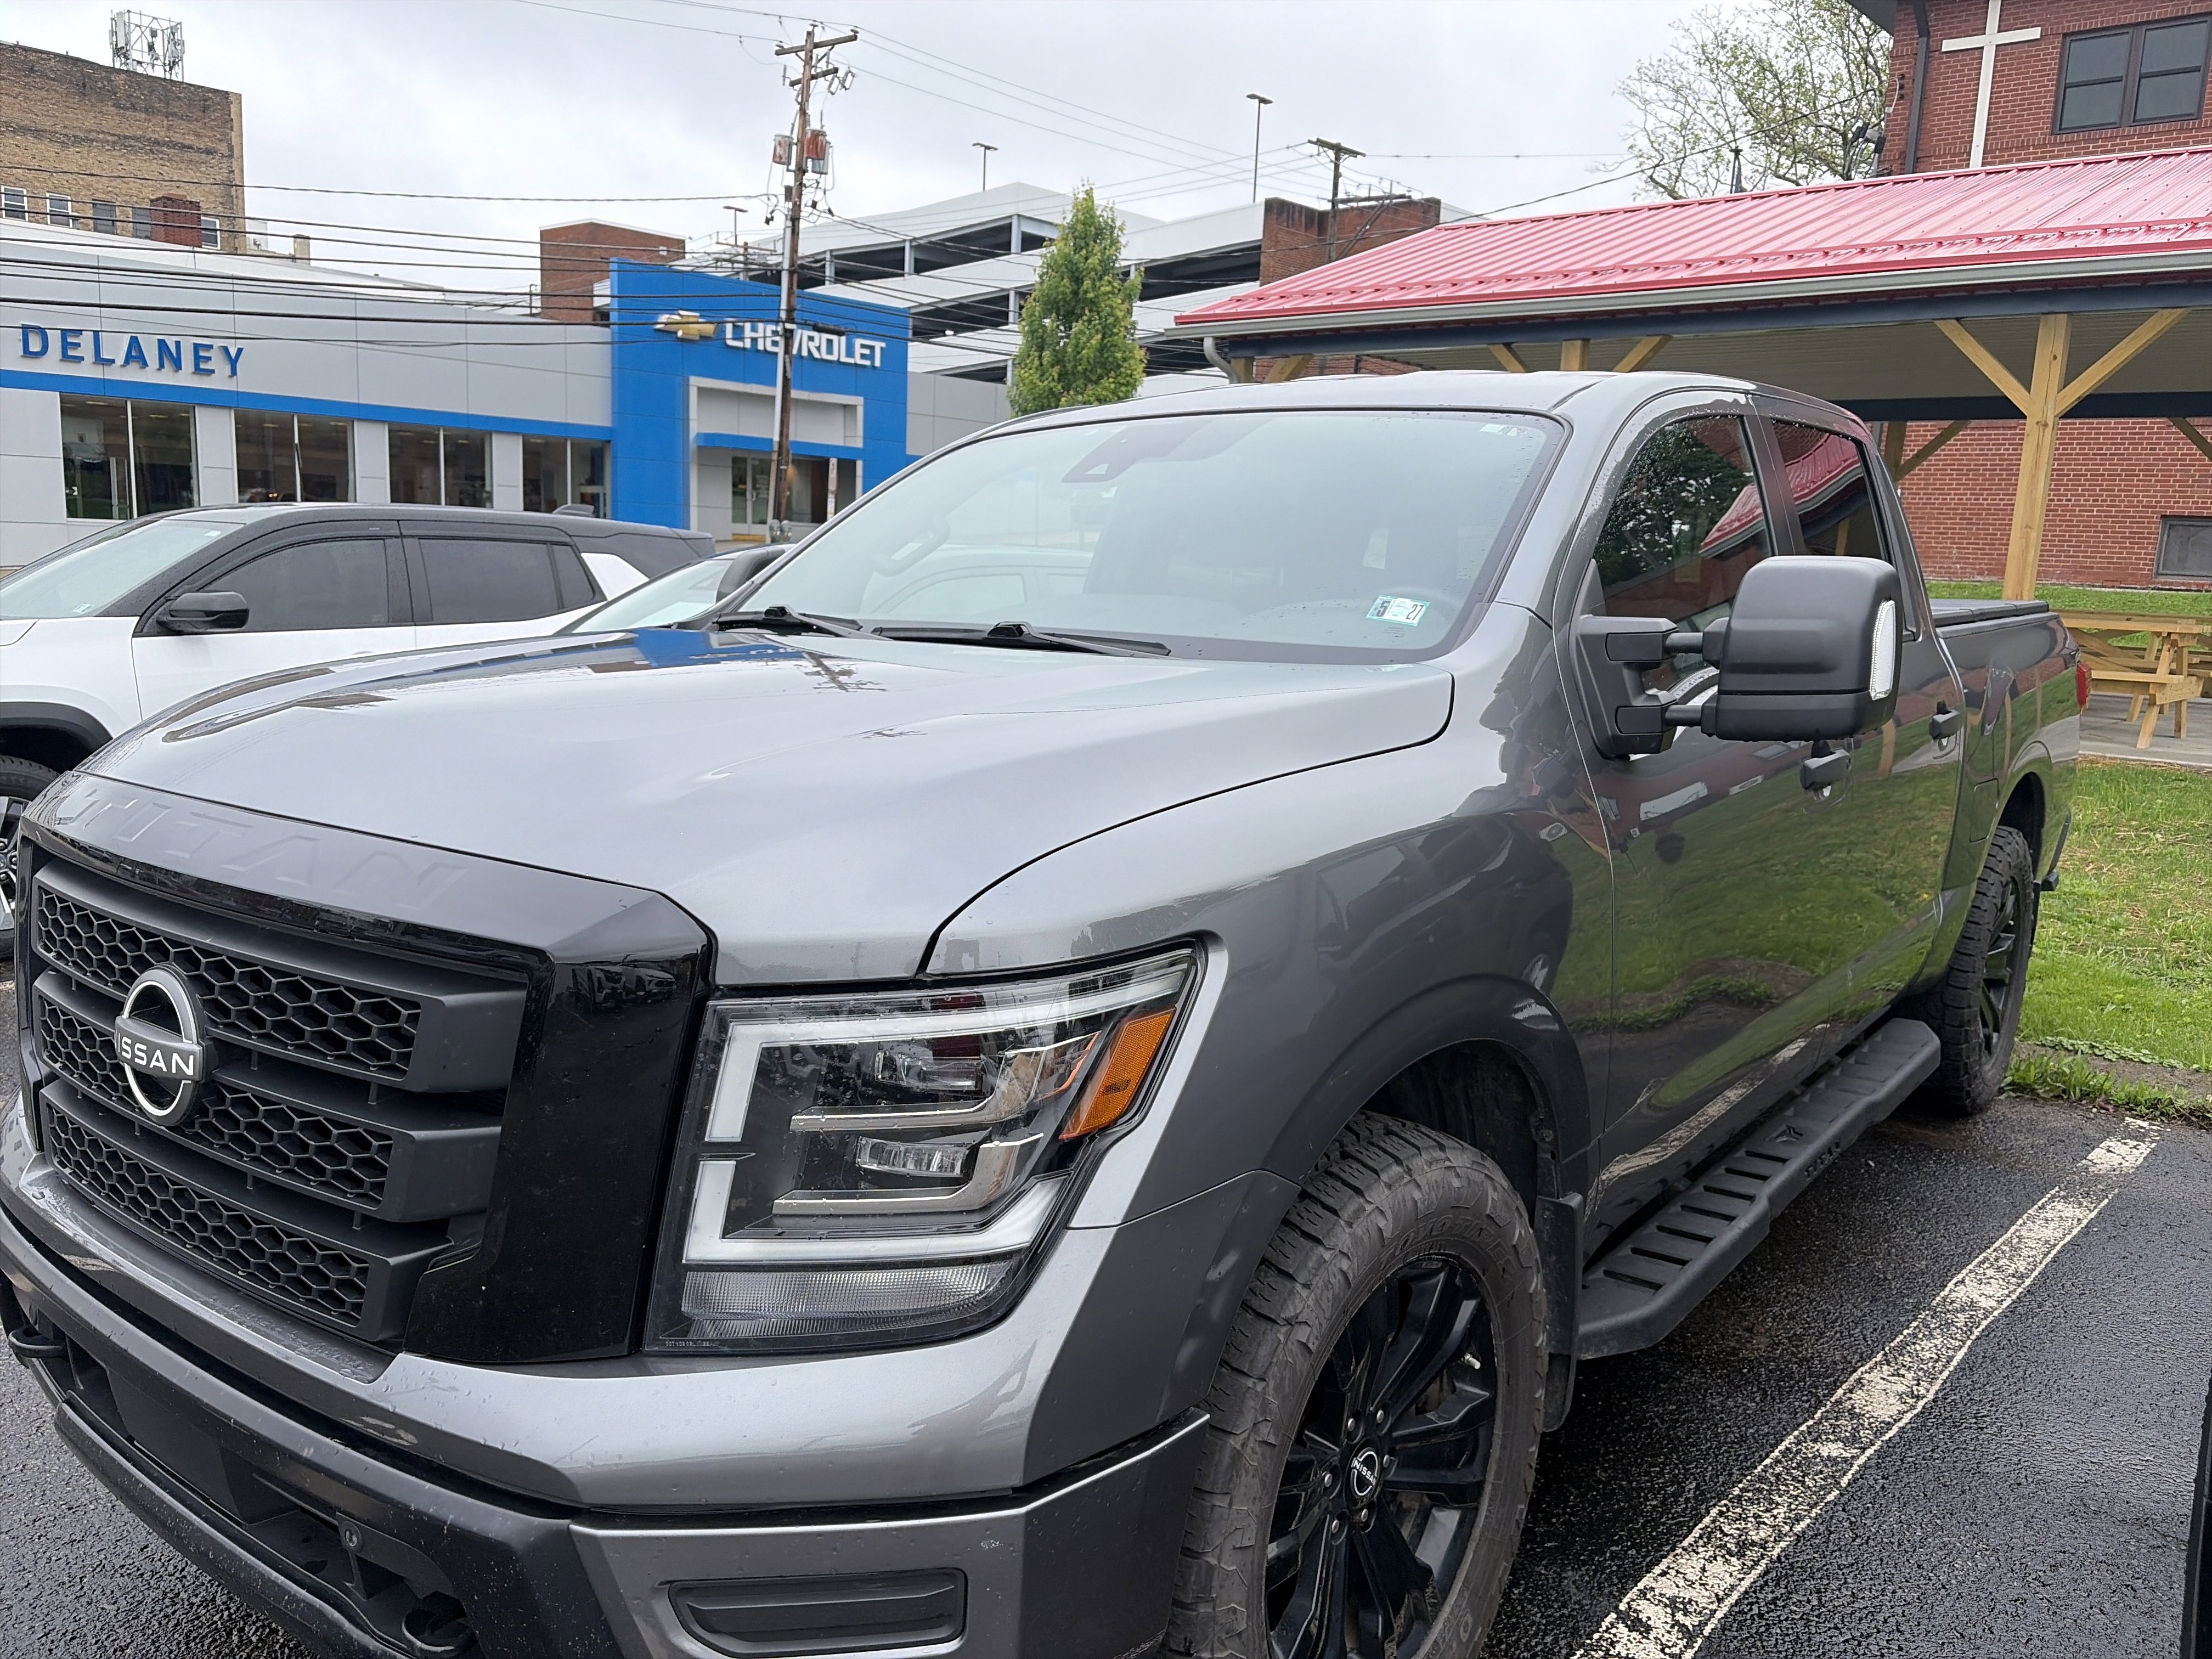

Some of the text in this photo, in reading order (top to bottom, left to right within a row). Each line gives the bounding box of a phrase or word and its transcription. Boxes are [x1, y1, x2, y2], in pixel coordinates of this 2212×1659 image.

[20, 323, 245, 377] DELANEY
[1405, 603, 1424, 621] 27
[56, 788, 470, 912] TITAN
[1353, 1459, 1377, 1486] NISSAN
